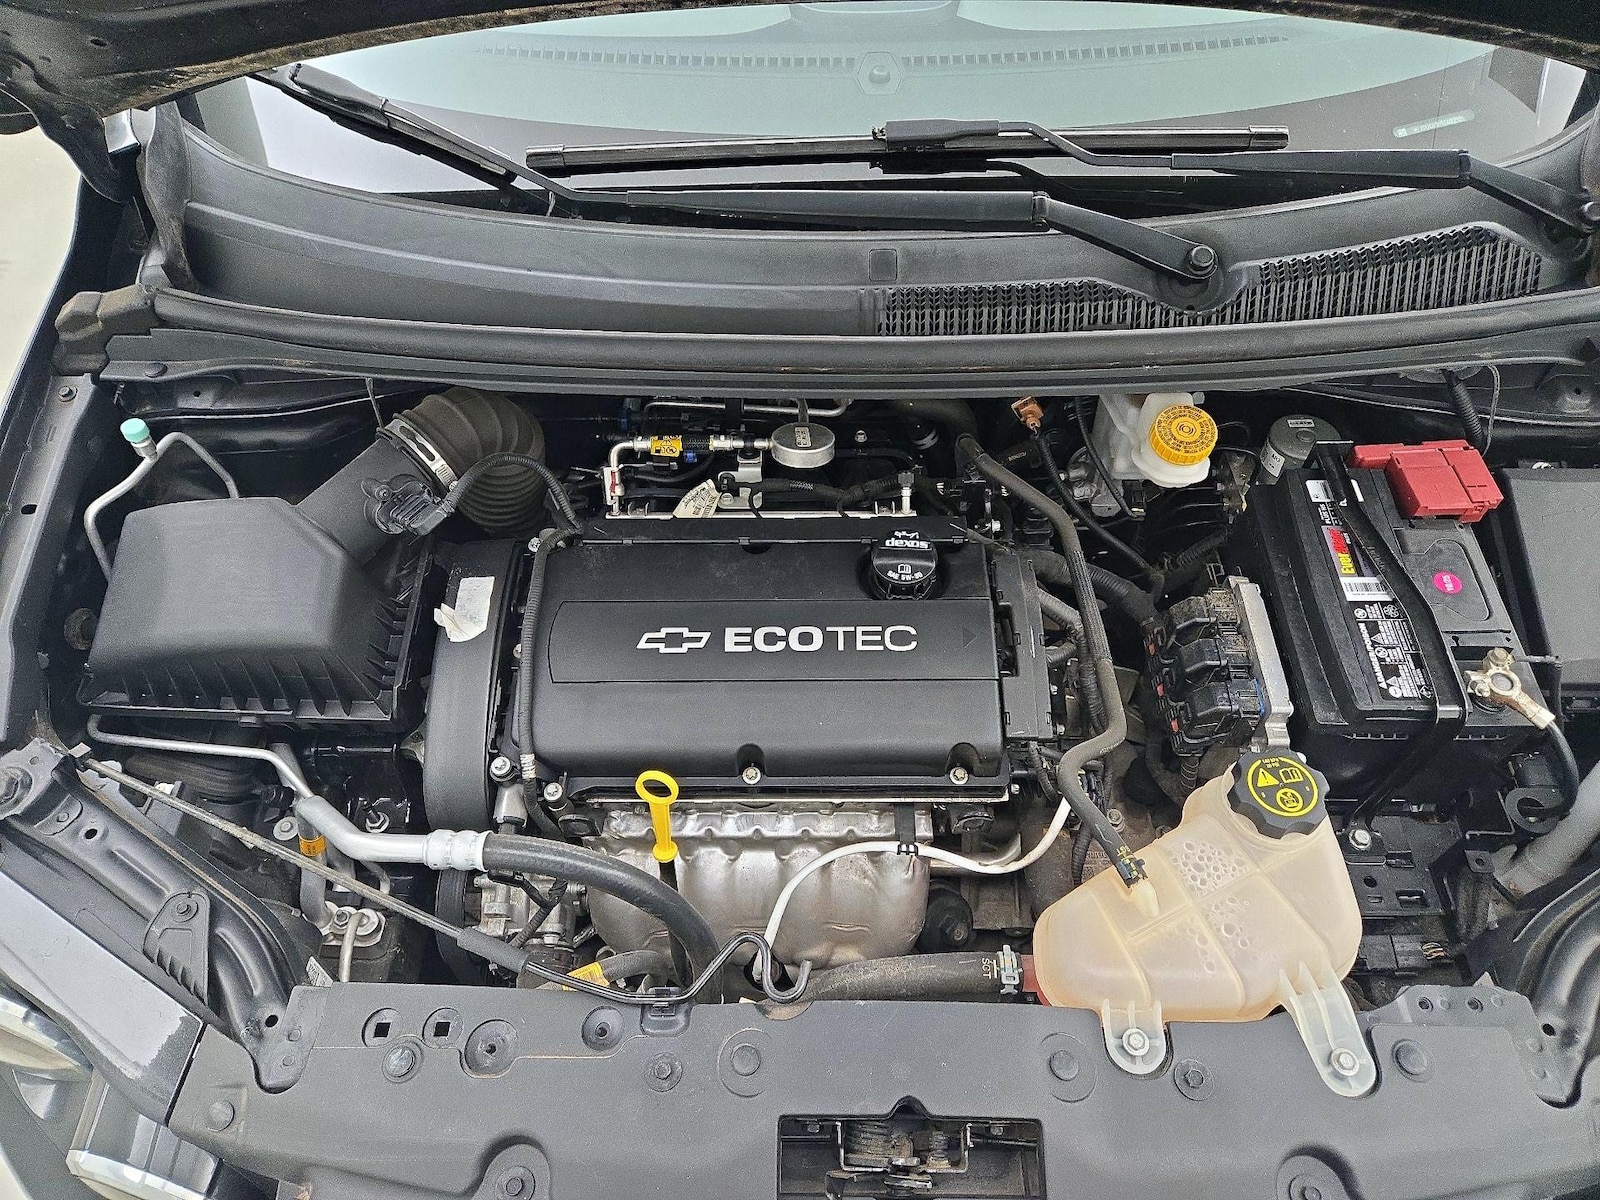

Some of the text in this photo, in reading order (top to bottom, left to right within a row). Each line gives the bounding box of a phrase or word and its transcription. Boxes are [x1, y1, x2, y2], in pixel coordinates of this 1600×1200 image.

[885, 538, 930, 549] dexos
[887, 570, 900, 580] SAE
[725, 625, 918, 652] ECOTEC
